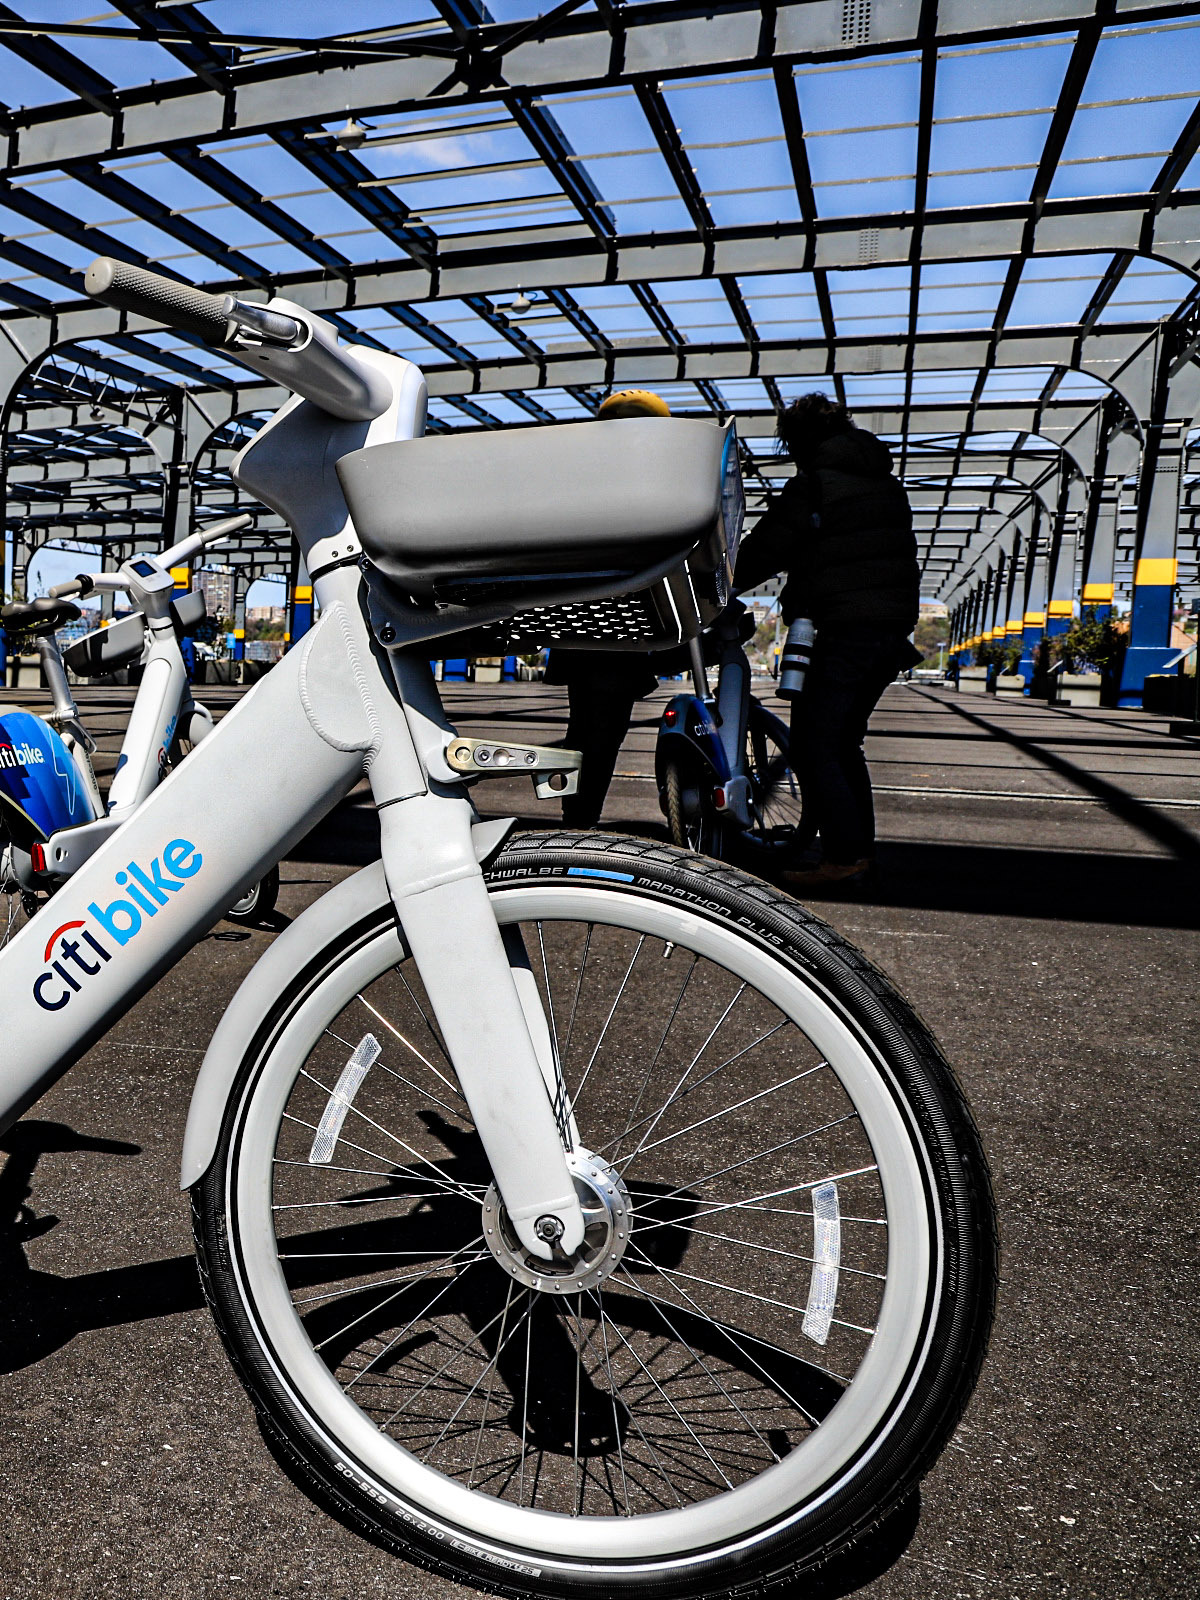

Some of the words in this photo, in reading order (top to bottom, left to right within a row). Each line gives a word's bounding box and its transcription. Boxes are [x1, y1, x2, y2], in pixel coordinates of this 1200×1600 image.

[33, 921, 113, 1012] citi
[87, 838, 203, 947] bike
[483, 866, 564, 881] CHWALBE
[637, 877, 732, 918] MARATHON
[737, 915, 784, 944] PLUS
[334, 1461, 388, 1505] 50-559
[394, 1507, 445, 1541] 26x2.00
